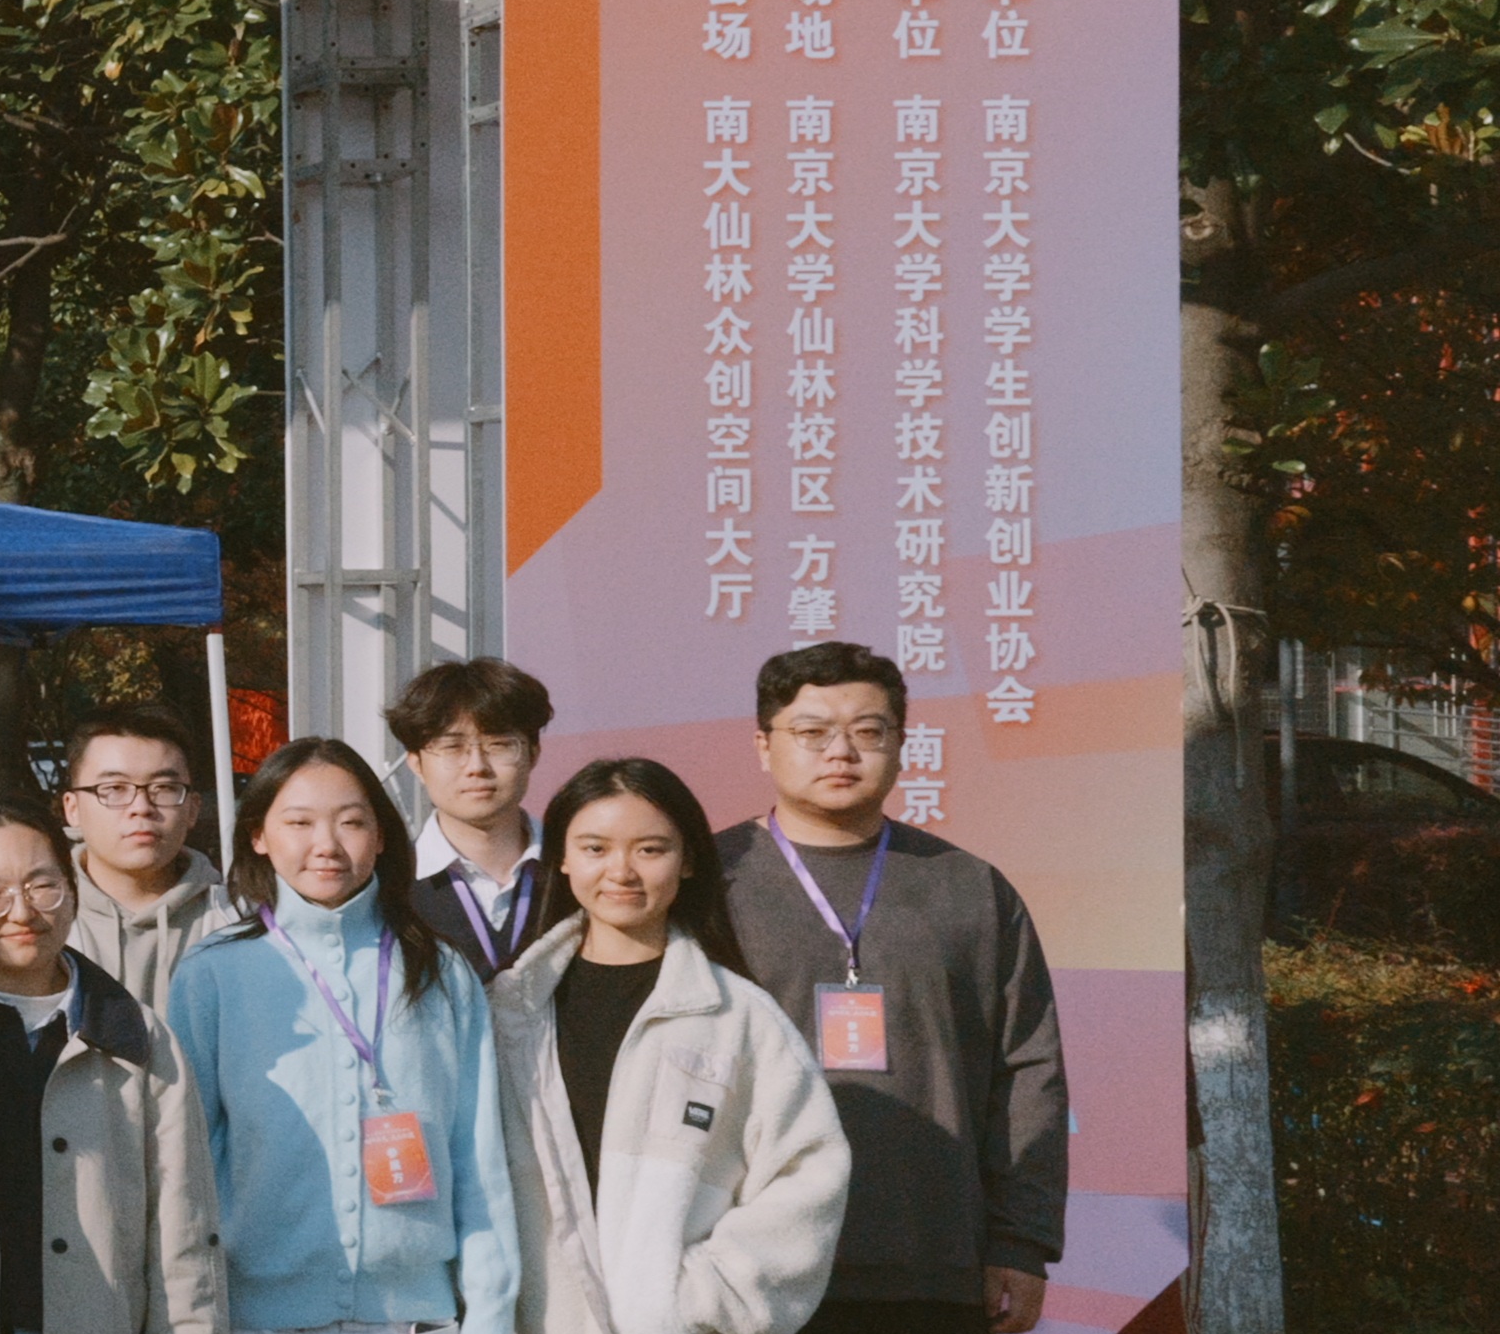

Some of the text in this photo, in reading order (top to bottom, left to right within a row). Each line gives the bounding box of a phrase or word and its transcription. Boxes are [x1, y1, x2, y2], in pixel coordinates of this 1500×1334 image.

[703, 95, 754, 620] 南大仙林众创空间大厅
[785, 95, 836, 513] 南京大学仙林校区
[892, 94, 946, 673] 南京大学科学技术研究院
[981, 94, 1036, 724] 南京大学学生创新创业协会
[787, 533, 837, 651] 方肇
